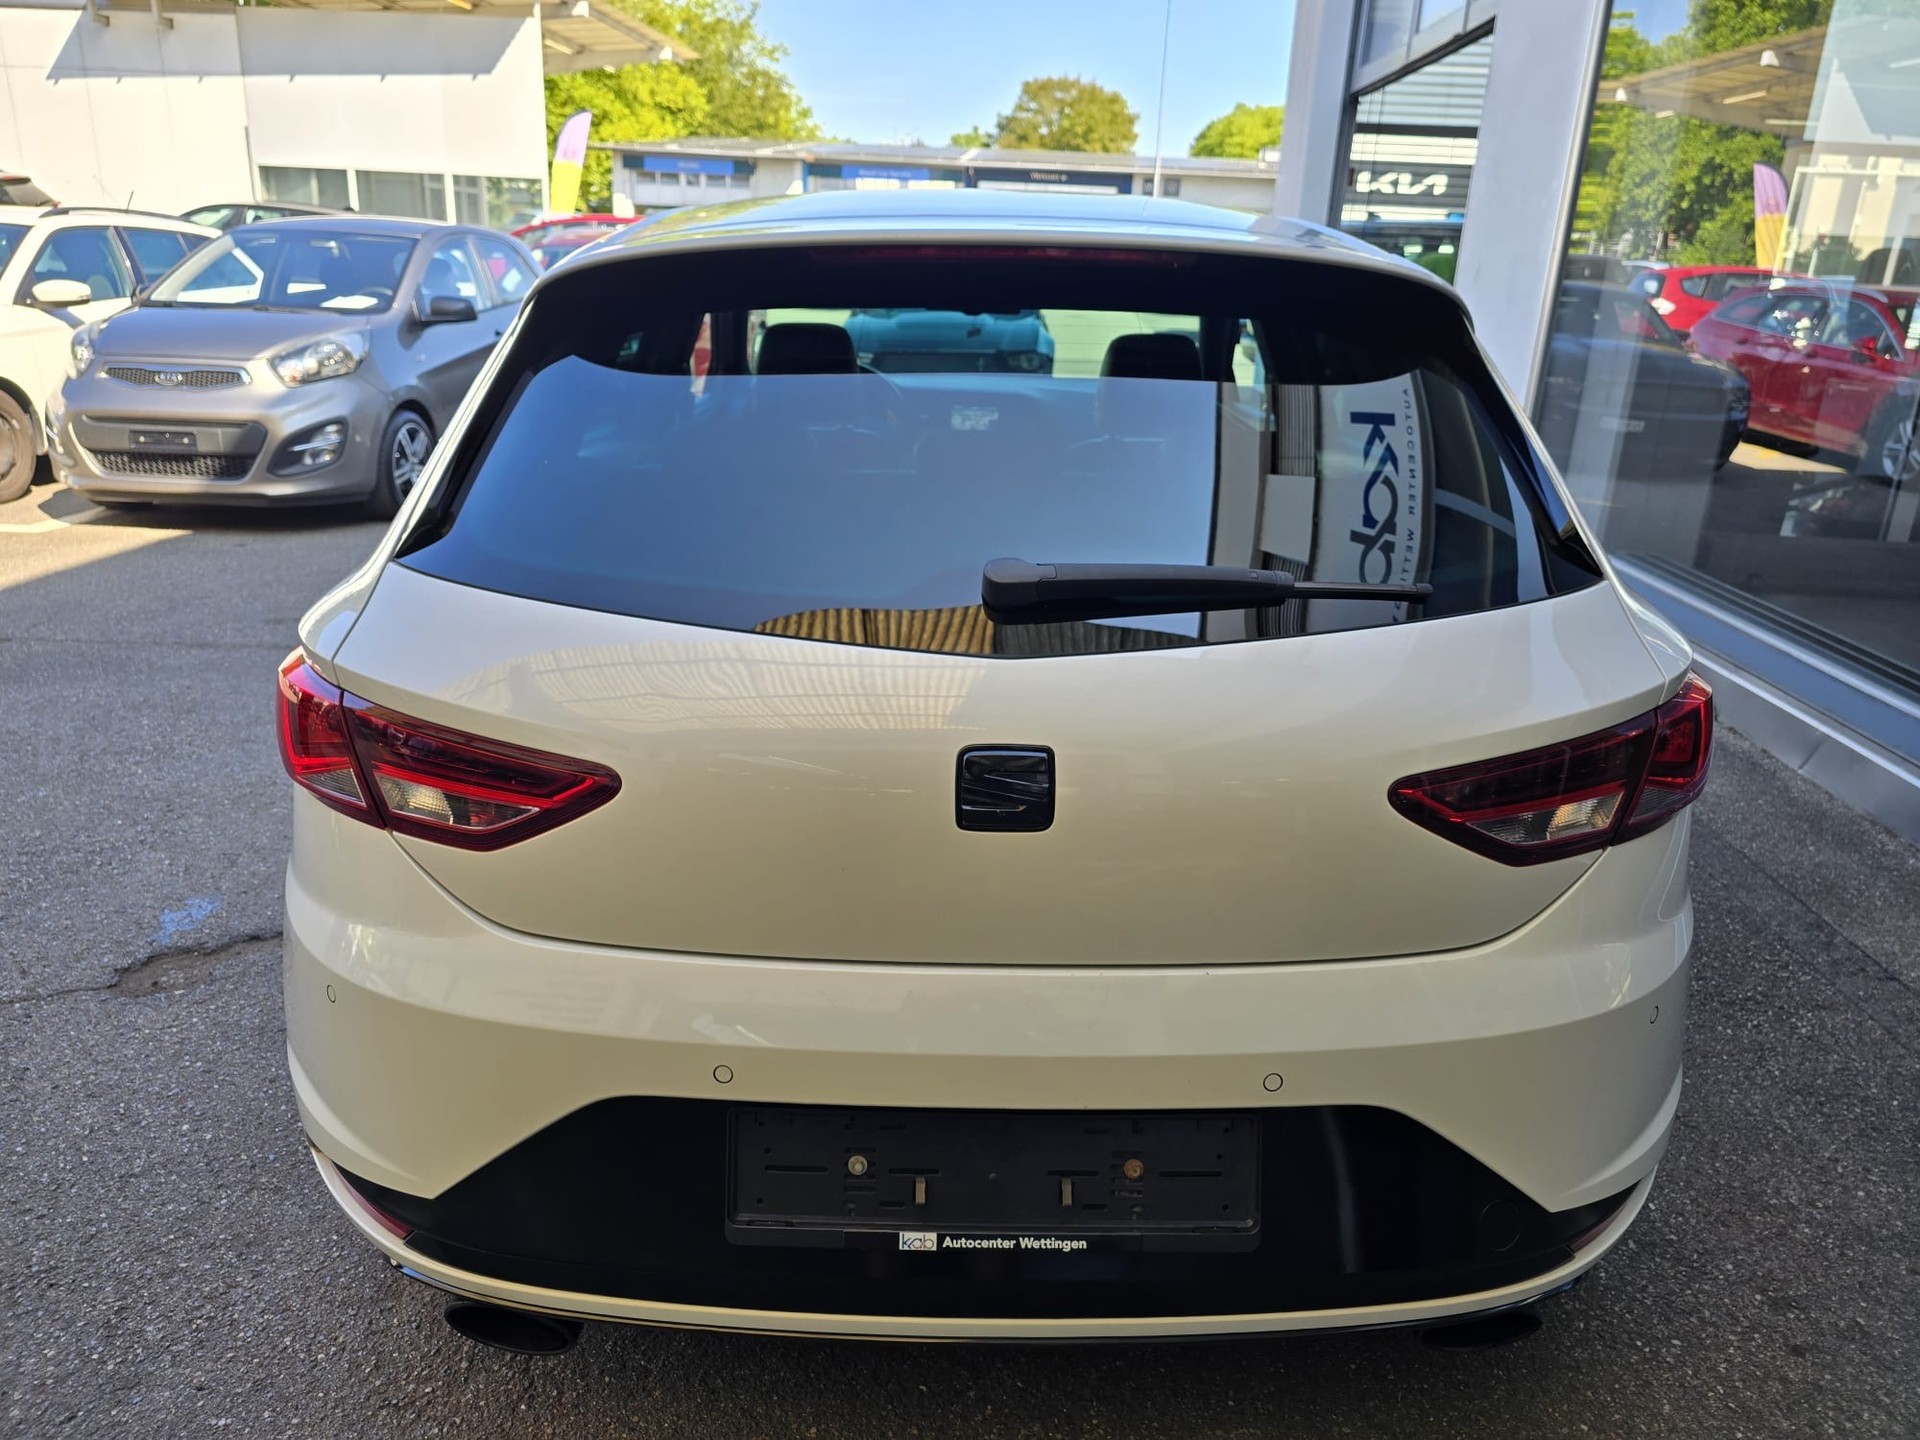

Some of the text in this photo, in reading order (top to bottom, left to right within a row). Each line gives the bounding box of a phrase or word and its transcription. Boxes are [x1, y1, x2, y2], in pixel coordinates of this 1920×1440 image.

[1355, 170, 1448, 196] KIA
[942, 1236, 1016, 1249] Autocenter
[1020, 1237, 1087, 1251] Wettingen
